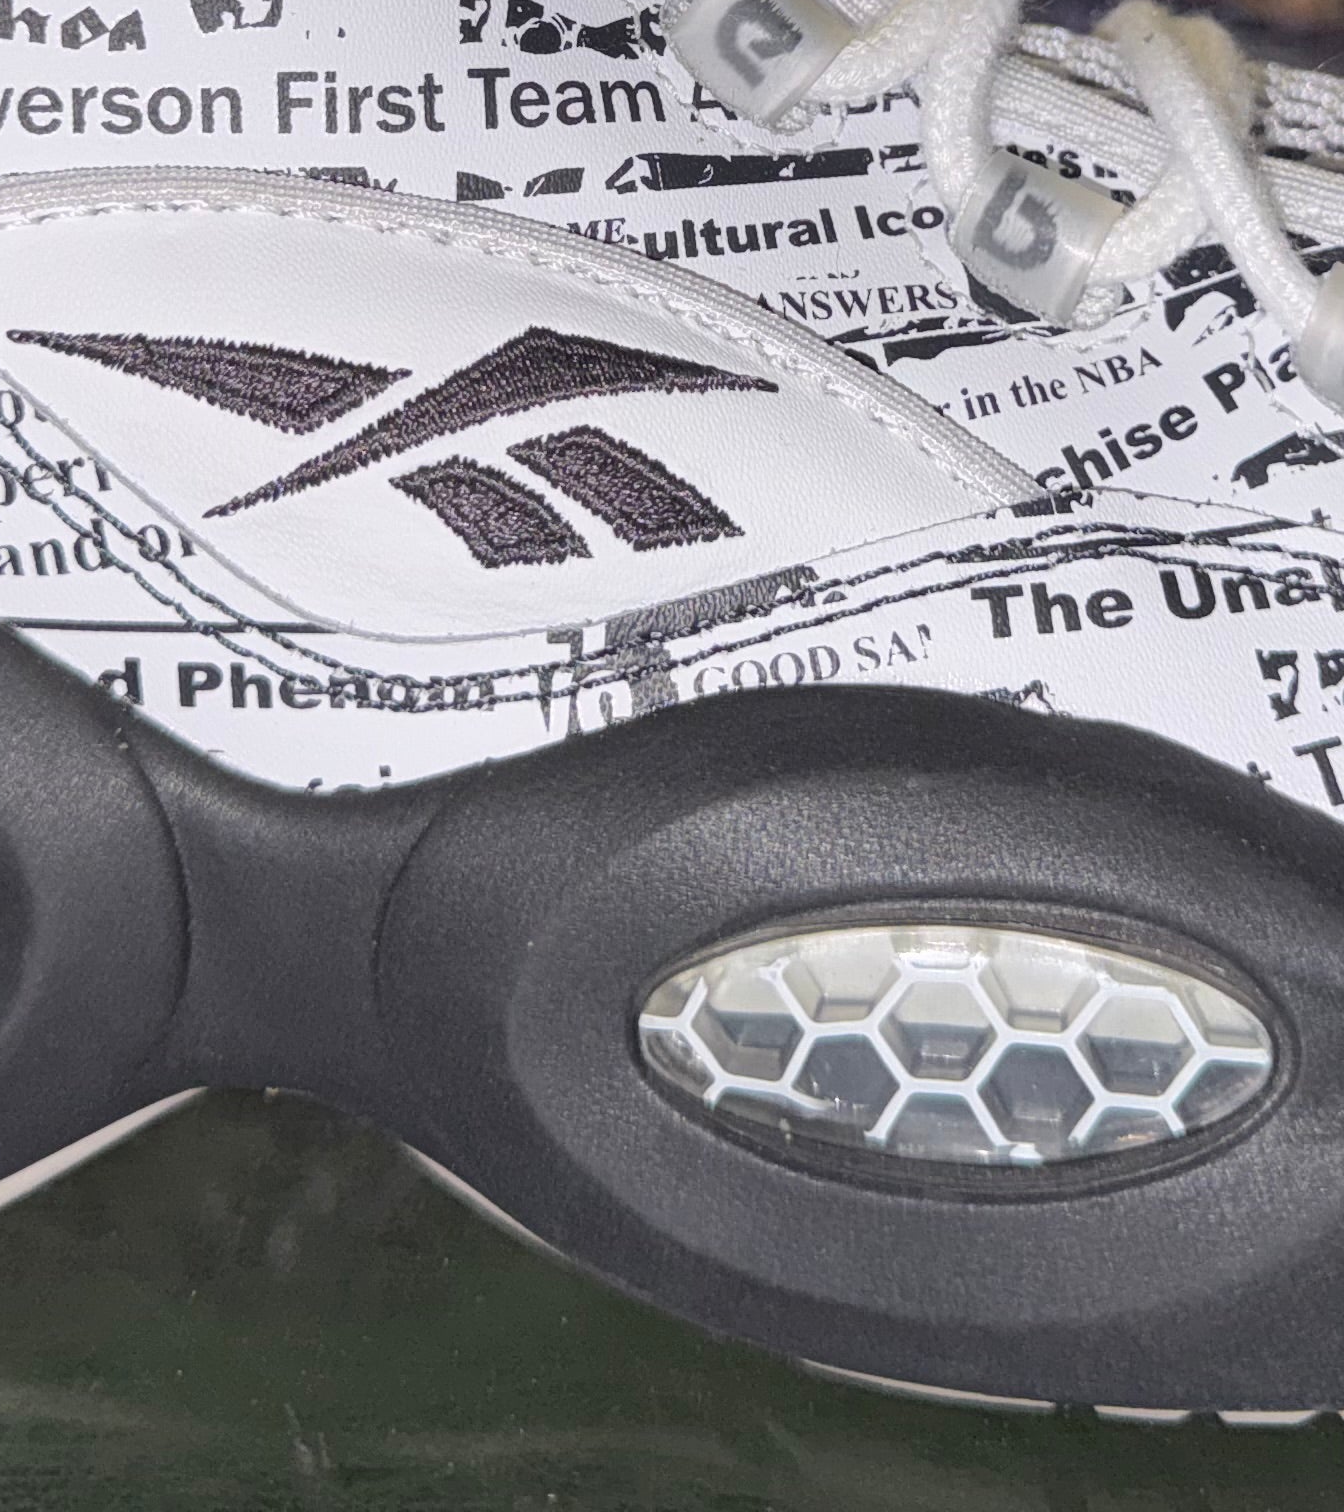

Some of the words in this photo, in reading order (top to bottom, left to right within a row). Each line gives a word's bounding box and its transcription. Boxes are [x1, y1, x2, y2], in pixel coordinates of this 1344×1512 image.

[276, 70, 446, 134] First
[467, 67, 666, 130] Team
[960, 384, 1001, 421] in
[1009, 374, 1069, 410] the
[1072, 345, 1164, 395] NBA
[970, 581, 1135, 639] The
